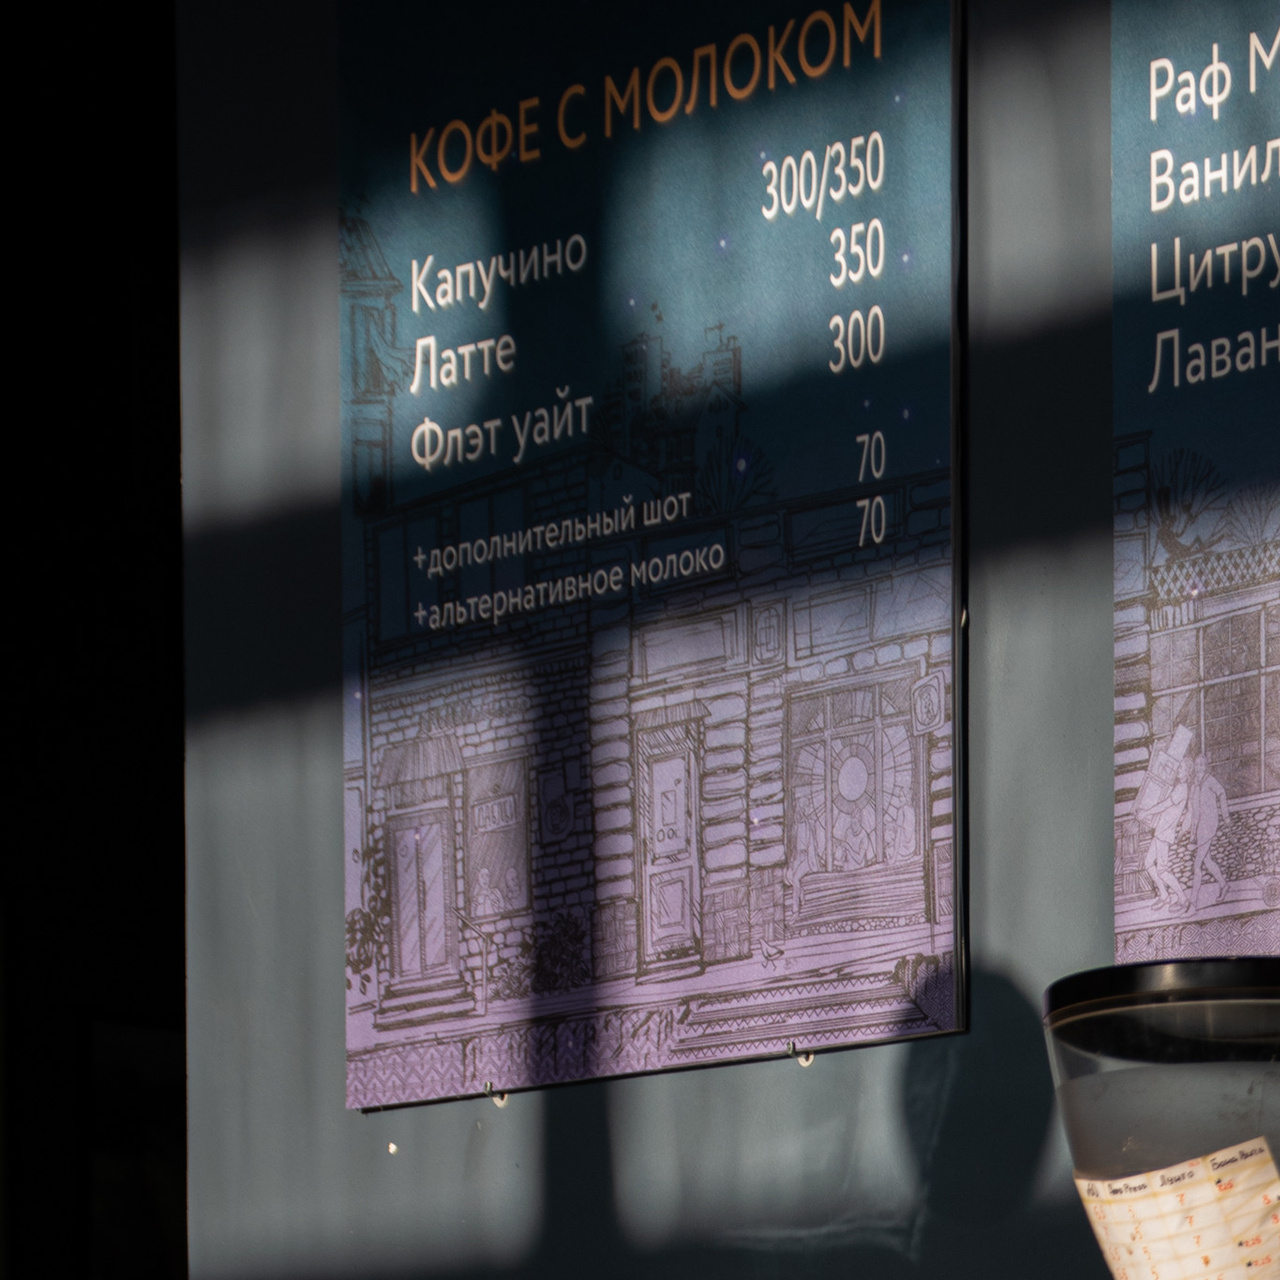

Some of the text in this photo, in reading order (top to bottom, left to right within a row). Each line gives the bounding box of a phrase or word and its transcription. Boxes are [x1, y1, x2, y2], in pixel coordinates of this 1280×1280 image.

[410, 0, 882, 194] КОФЕ С МОЛОКОМ
[1150, 44, 1231, 122] Раф
[761, 131, 885, 221] 300/350
[411, 234, 587, 313] Капучино
[829, 218, 885, 288] 350
[410, 334, 517, 395] Латте
[828, 305, 885, 374] 300
[411, 386, 594, 472] Флэт уайт
[856, 430, 886, 483] 70
[413, 491, 692, 580] +дополнительный шот
[856, 496, 886, 547] 70
[414, 543, 725, 632] +альтернативное молоко
